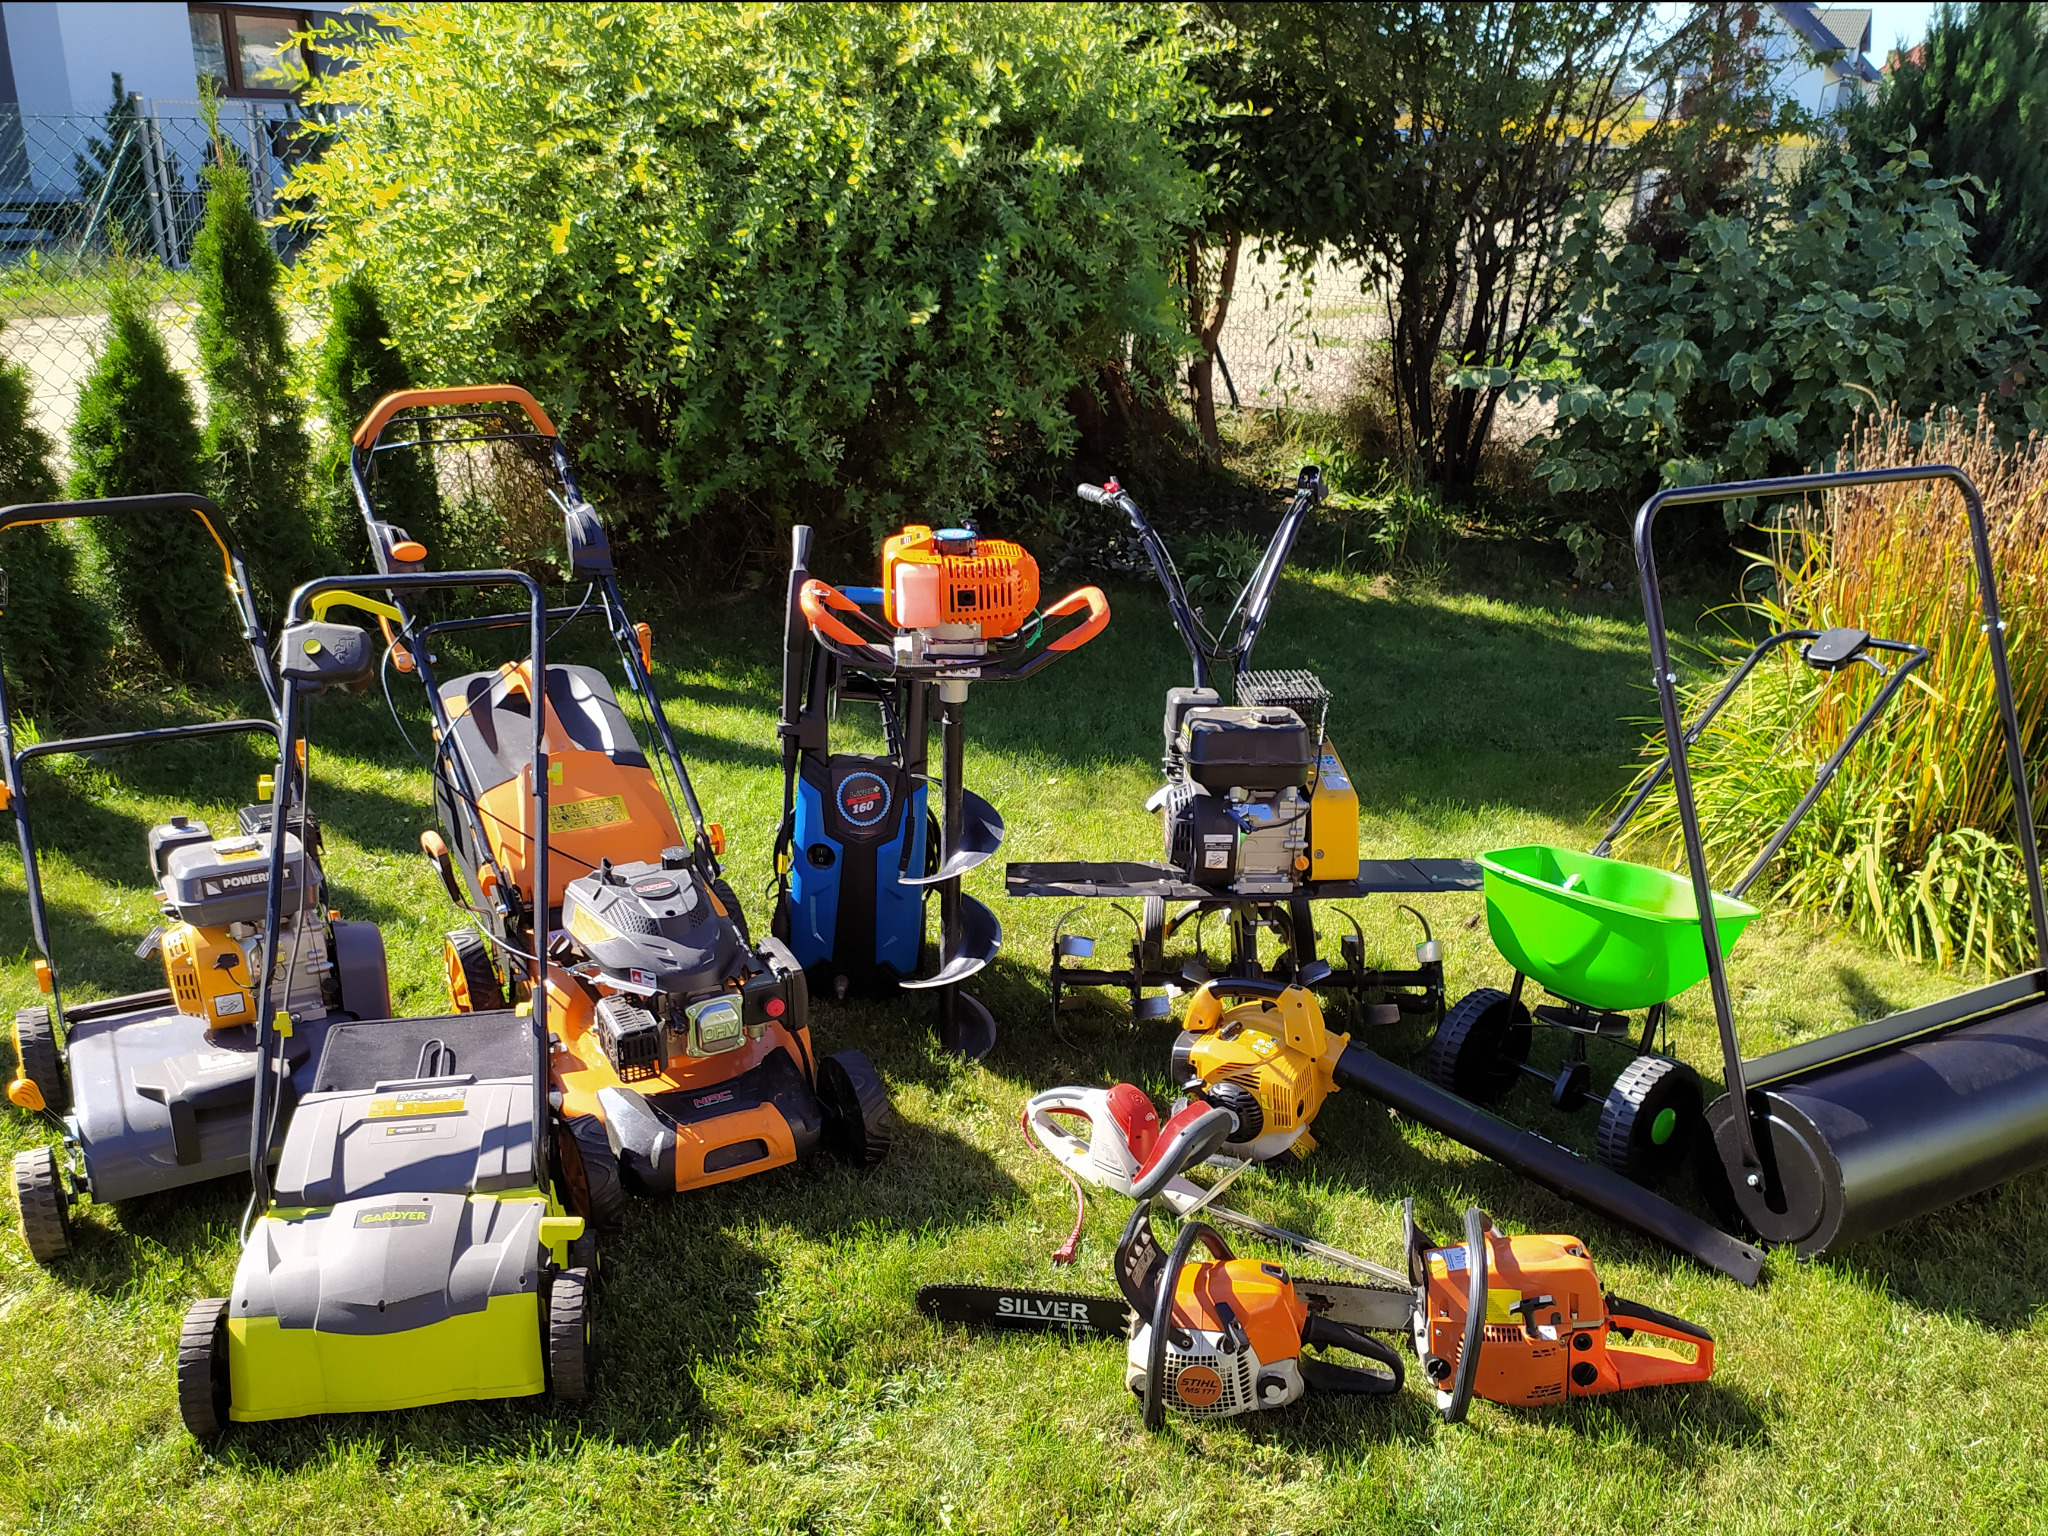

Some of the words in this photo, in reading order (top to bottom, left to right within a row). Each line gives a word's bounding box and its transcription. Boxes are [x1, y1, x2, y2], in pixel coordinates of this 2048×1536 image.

[852, 801, 874, 814] 160
[222, 868, 290, 889] POWERT
[704, 1020, 738, 1040] OHV
[361, 1211, 426, 1223] GARDYER
[998, 1297, 1089, 1320] SILVER
[1180, 1378, 1218, 1388] STIHL
